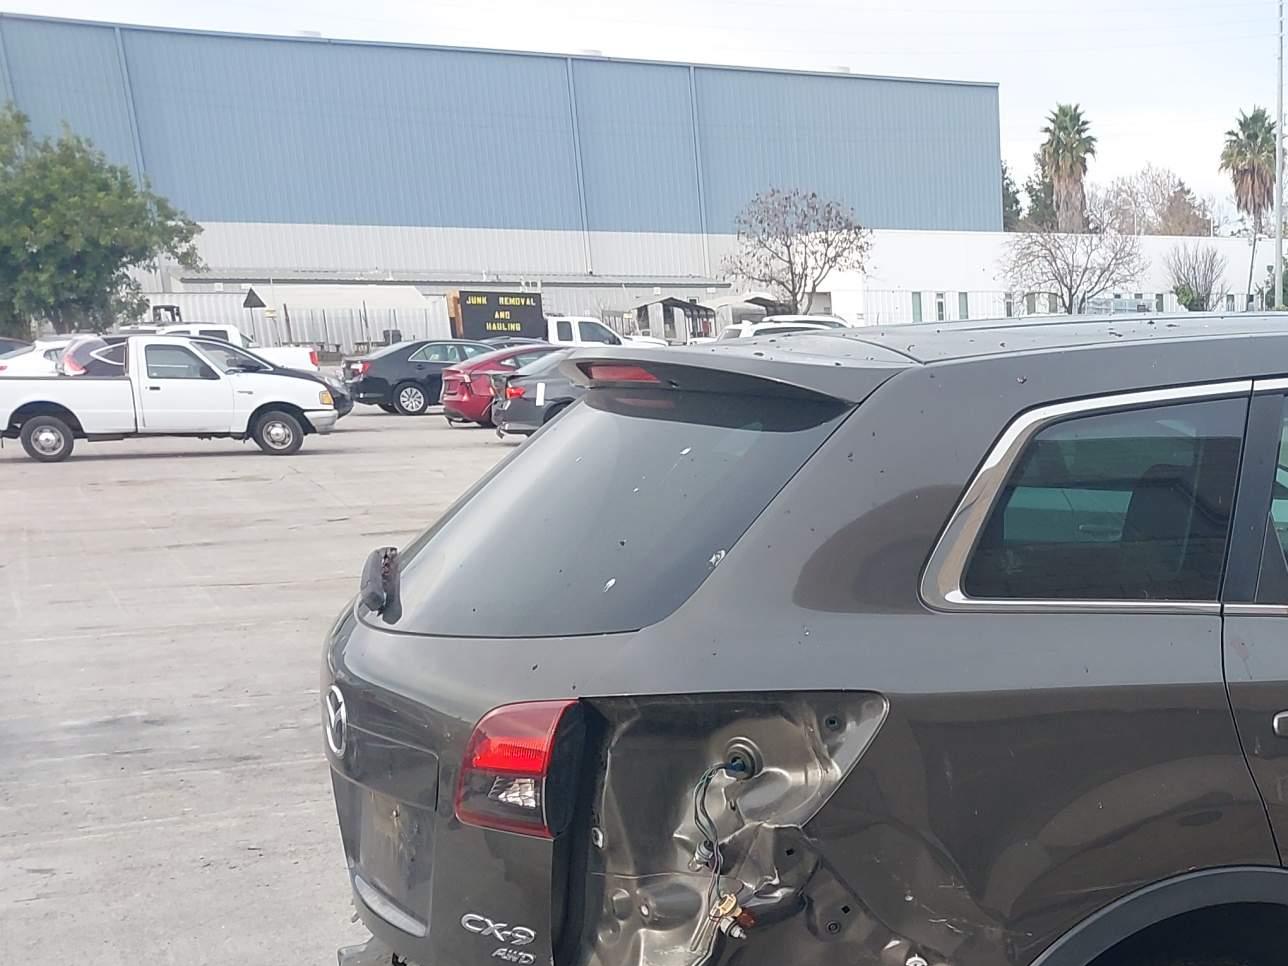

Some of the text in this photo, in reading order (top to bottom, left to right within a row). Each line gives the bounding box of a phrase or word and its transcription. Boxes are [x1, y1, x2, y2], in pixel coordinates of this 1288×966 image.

[466, 296, 536, 306] JUNK REMOVAL
[494, 311, 511, 319] AND
[486, 322, 521, 331] HAULING
[461, 913, 536, 946] CX-9
[491, 948, 536, 965] AWD
